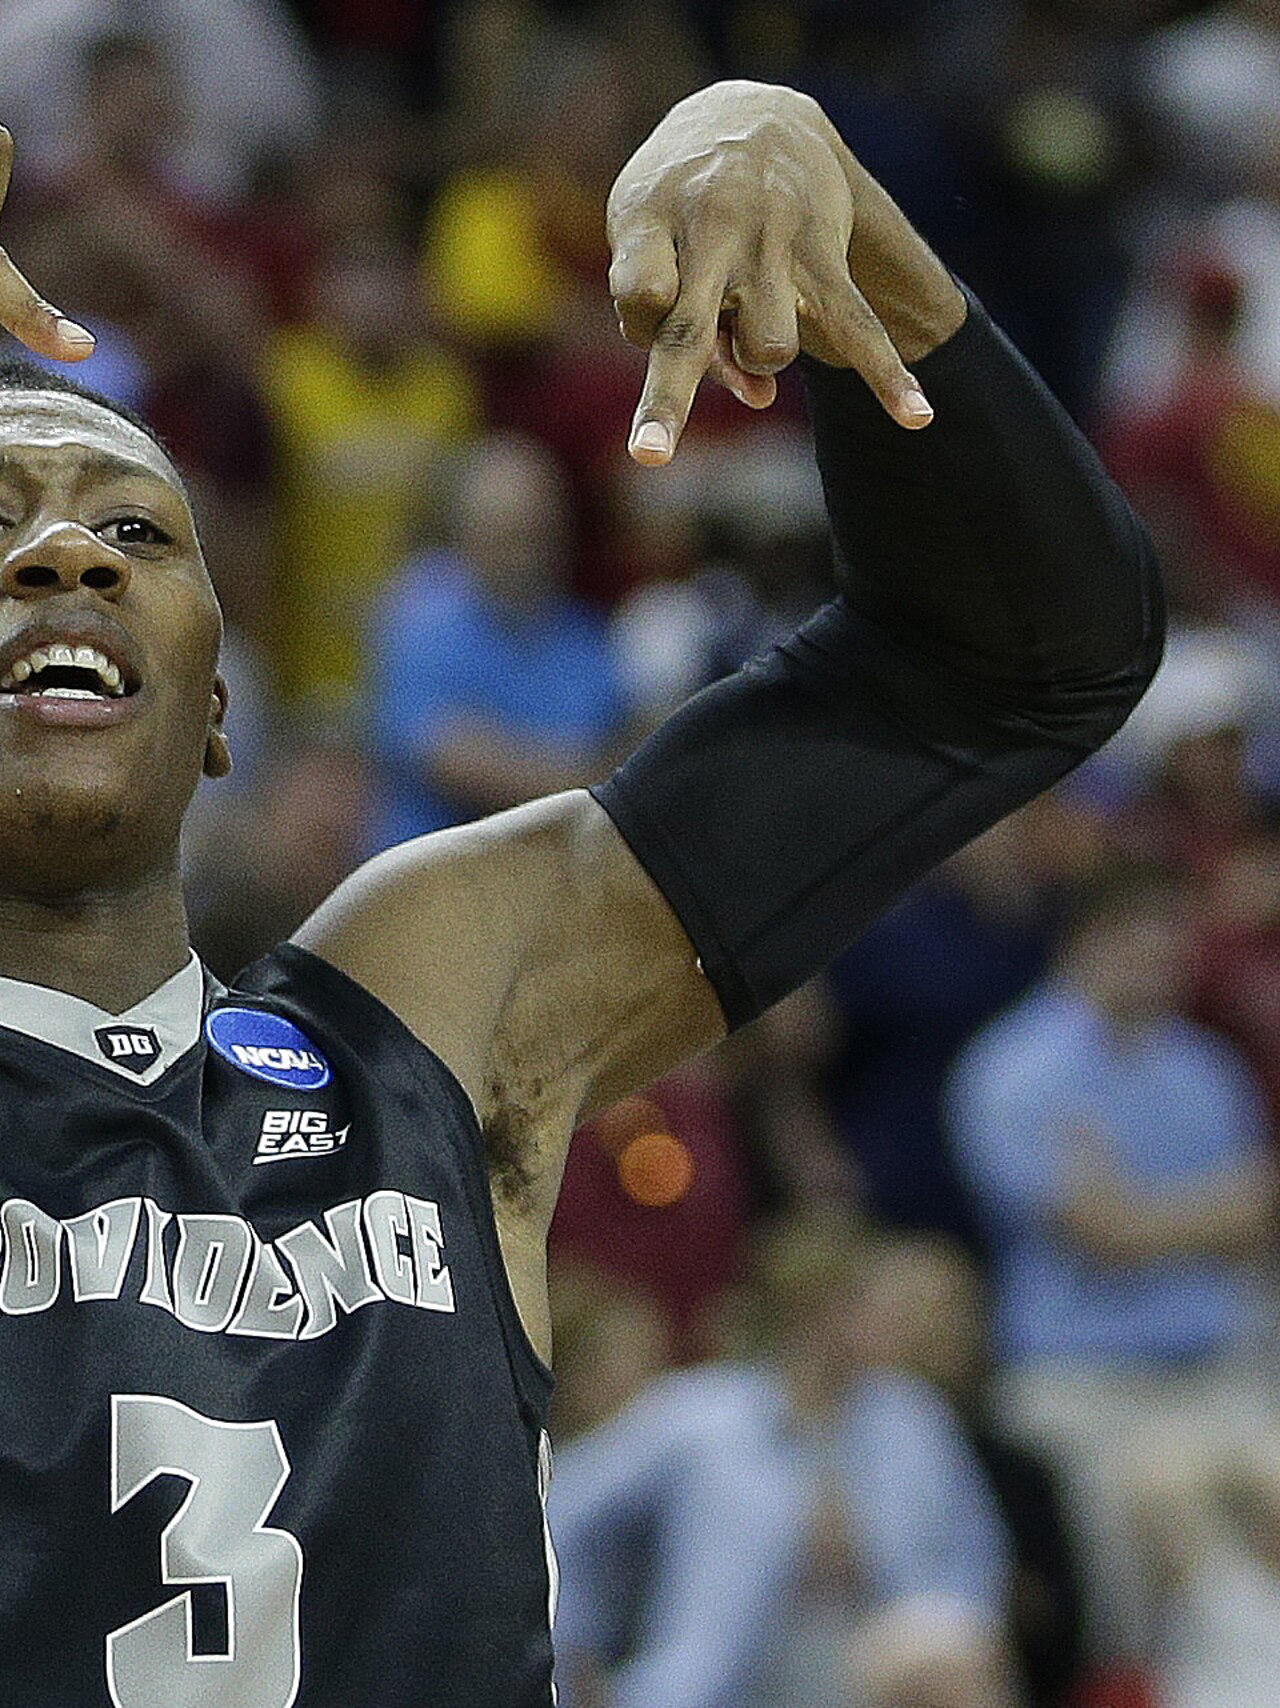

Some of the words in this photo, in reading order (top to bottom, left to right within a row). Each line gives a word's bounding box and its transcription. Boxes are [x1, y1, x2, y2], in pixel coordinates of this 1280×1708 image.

[231, 1044, 324, 1071] NCAA
[261, 1111, 328, 1133] BIG
[256, 1122, 352, 1153] EAST
[106, 1394, 303, 1708] 3
